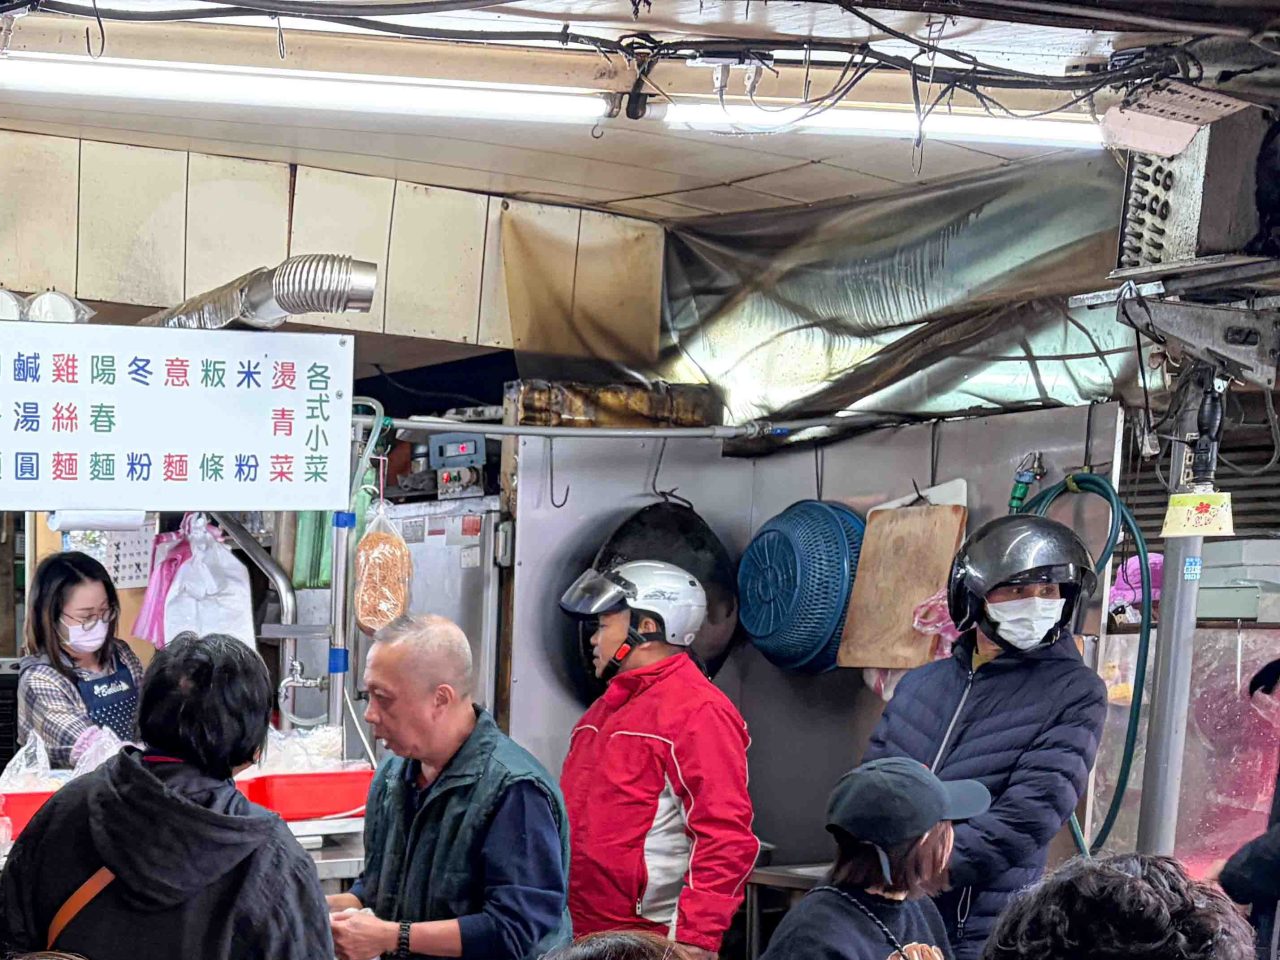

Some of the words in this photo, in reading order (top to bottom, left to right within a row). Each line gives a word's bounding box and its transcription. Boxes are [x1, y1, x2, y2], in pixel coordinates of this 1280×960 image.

[13, 352, 41, 480] 鹹湯圓
[51, 353, 79, 481] 雞絲麵
[89, 355, 116, 482] 陽春麵
[126, 356, 154, 482] 冬粉
[163, 357, 190, 482] 意麵
[234, 360, 261, 483] 米粉
[269, 361, 297, 483] 燙青菜
[304, 363, 332, 483] 各式小菜
